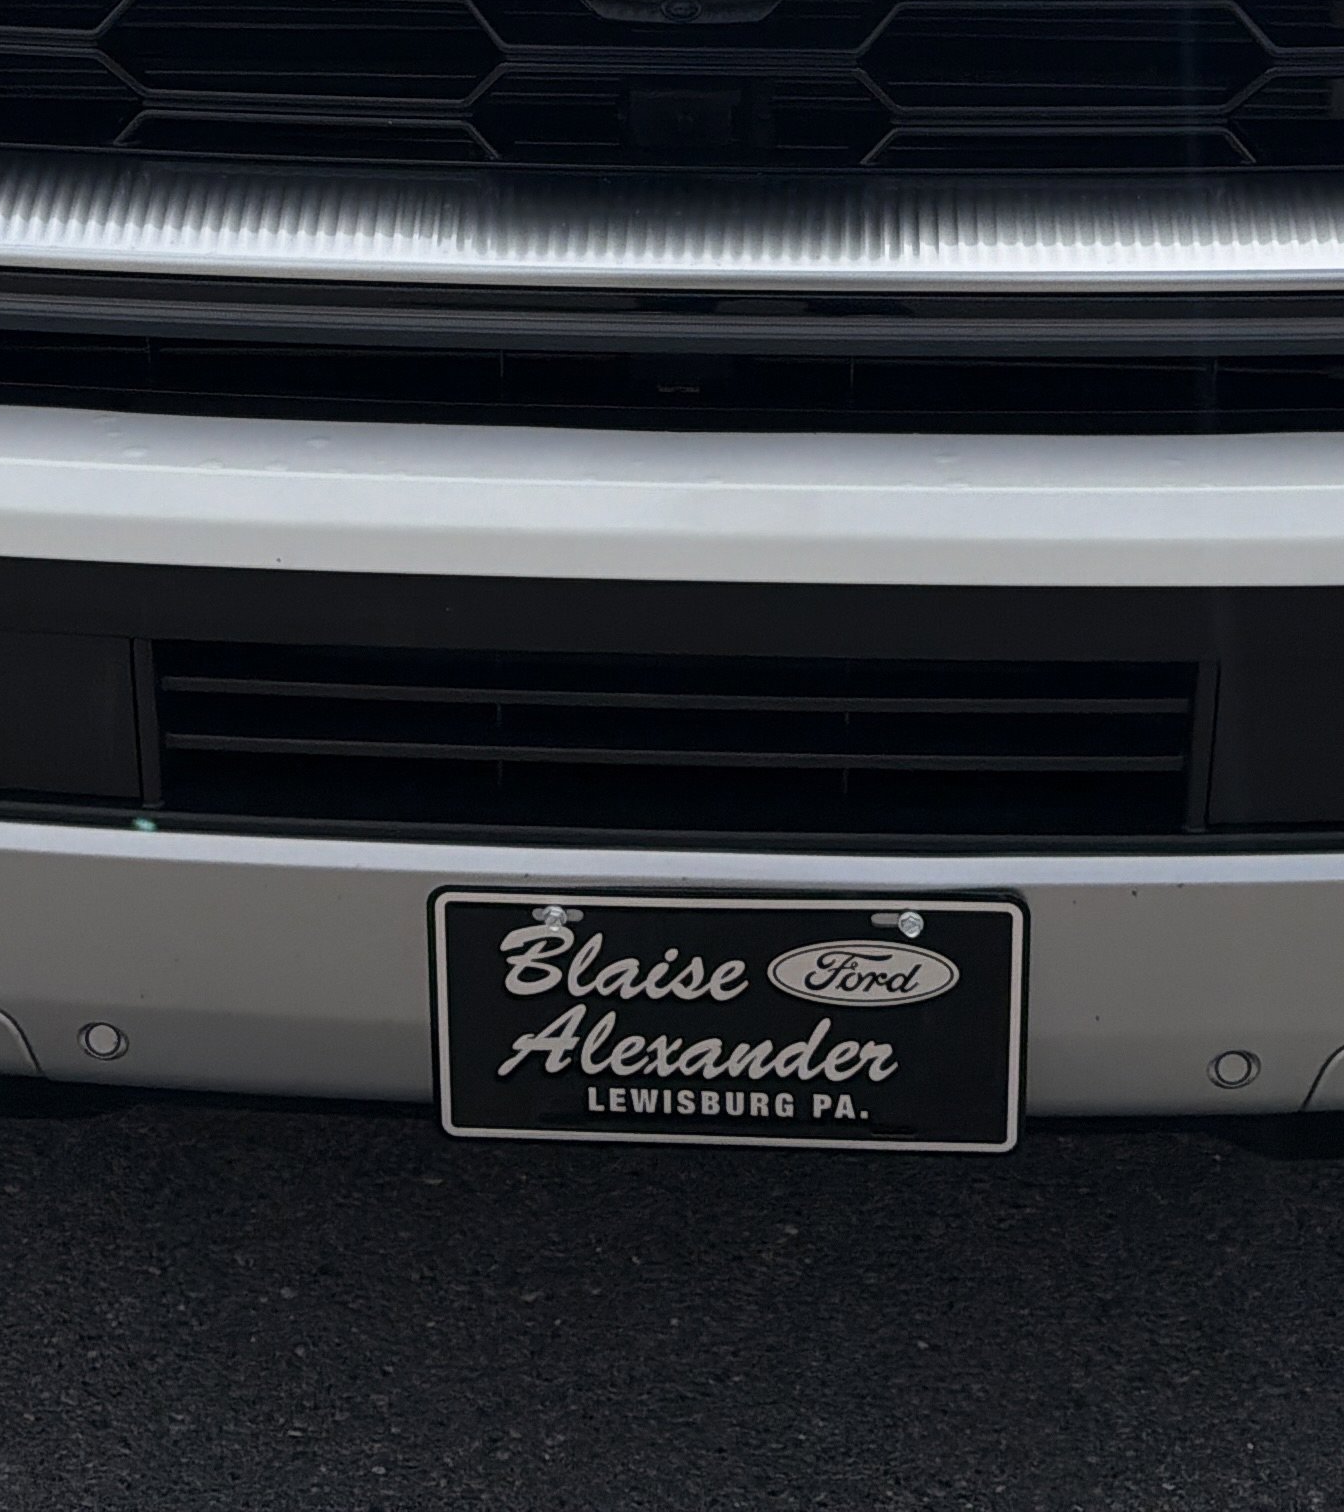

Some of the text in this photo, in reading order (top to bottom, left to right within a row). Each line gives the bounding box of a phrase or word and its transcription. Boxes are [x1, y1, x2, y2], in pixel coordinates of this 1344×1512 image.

[499, 923, 750, 1002] Blaise
[804, 952, 923, 994] Ford
[497, 1003, 899, 1083] Alexander
[587, 1086, 870, 1120] LEWISBURG PA.
